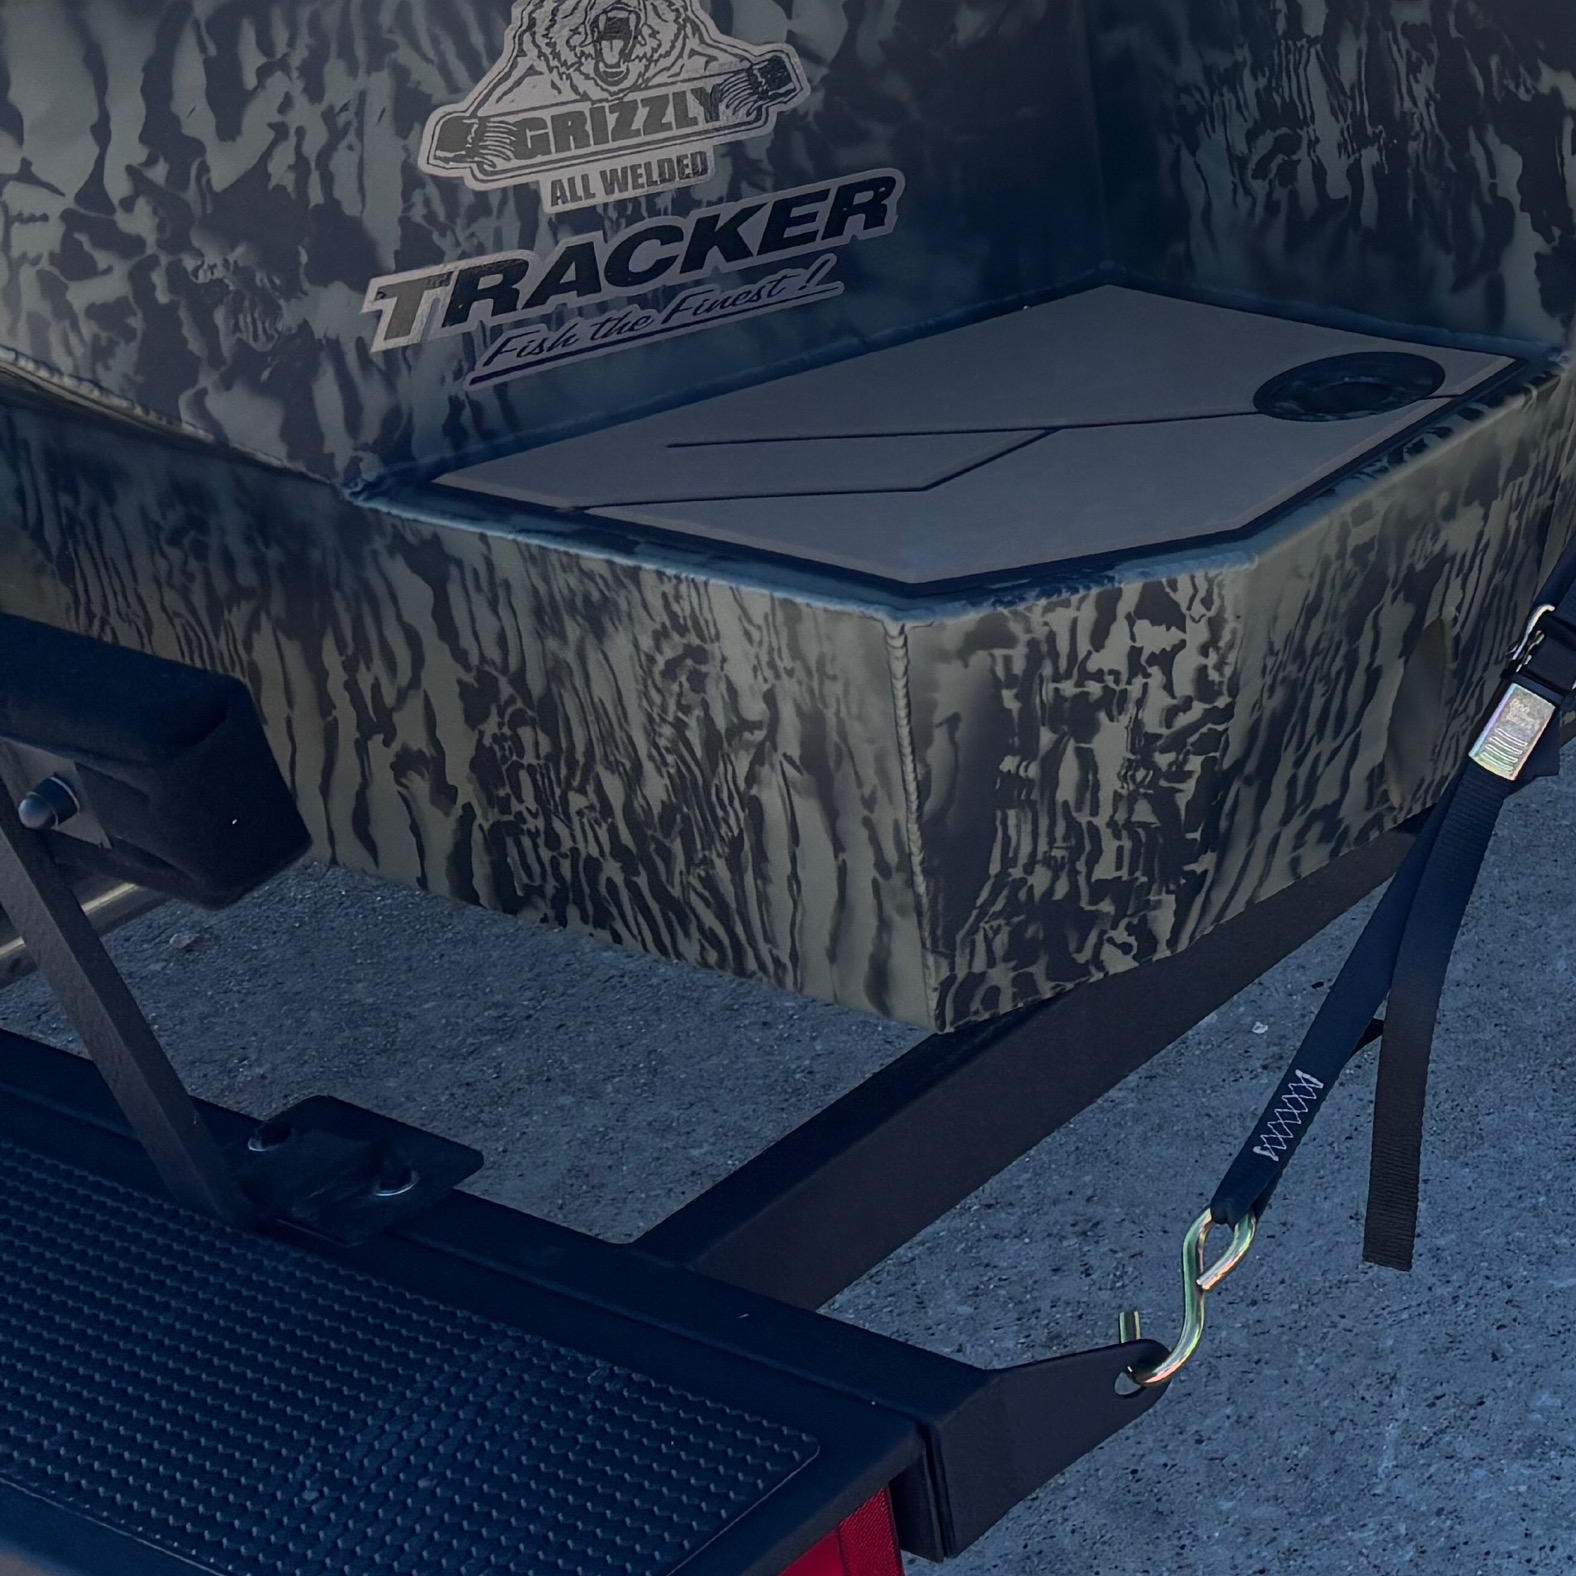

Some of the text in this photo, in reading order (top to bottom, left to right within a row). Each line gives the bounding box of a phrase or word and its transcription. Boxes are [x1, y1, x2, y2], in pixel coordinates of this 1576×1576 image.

[514, 84, 722, 159] GRIZZLY
[550, 151, 709, 207] ALL WELDED
[376, 176, 898, 343] TRACKER
[483, 325, 579, 367] Fish
[586, 313, 653, 342] the
